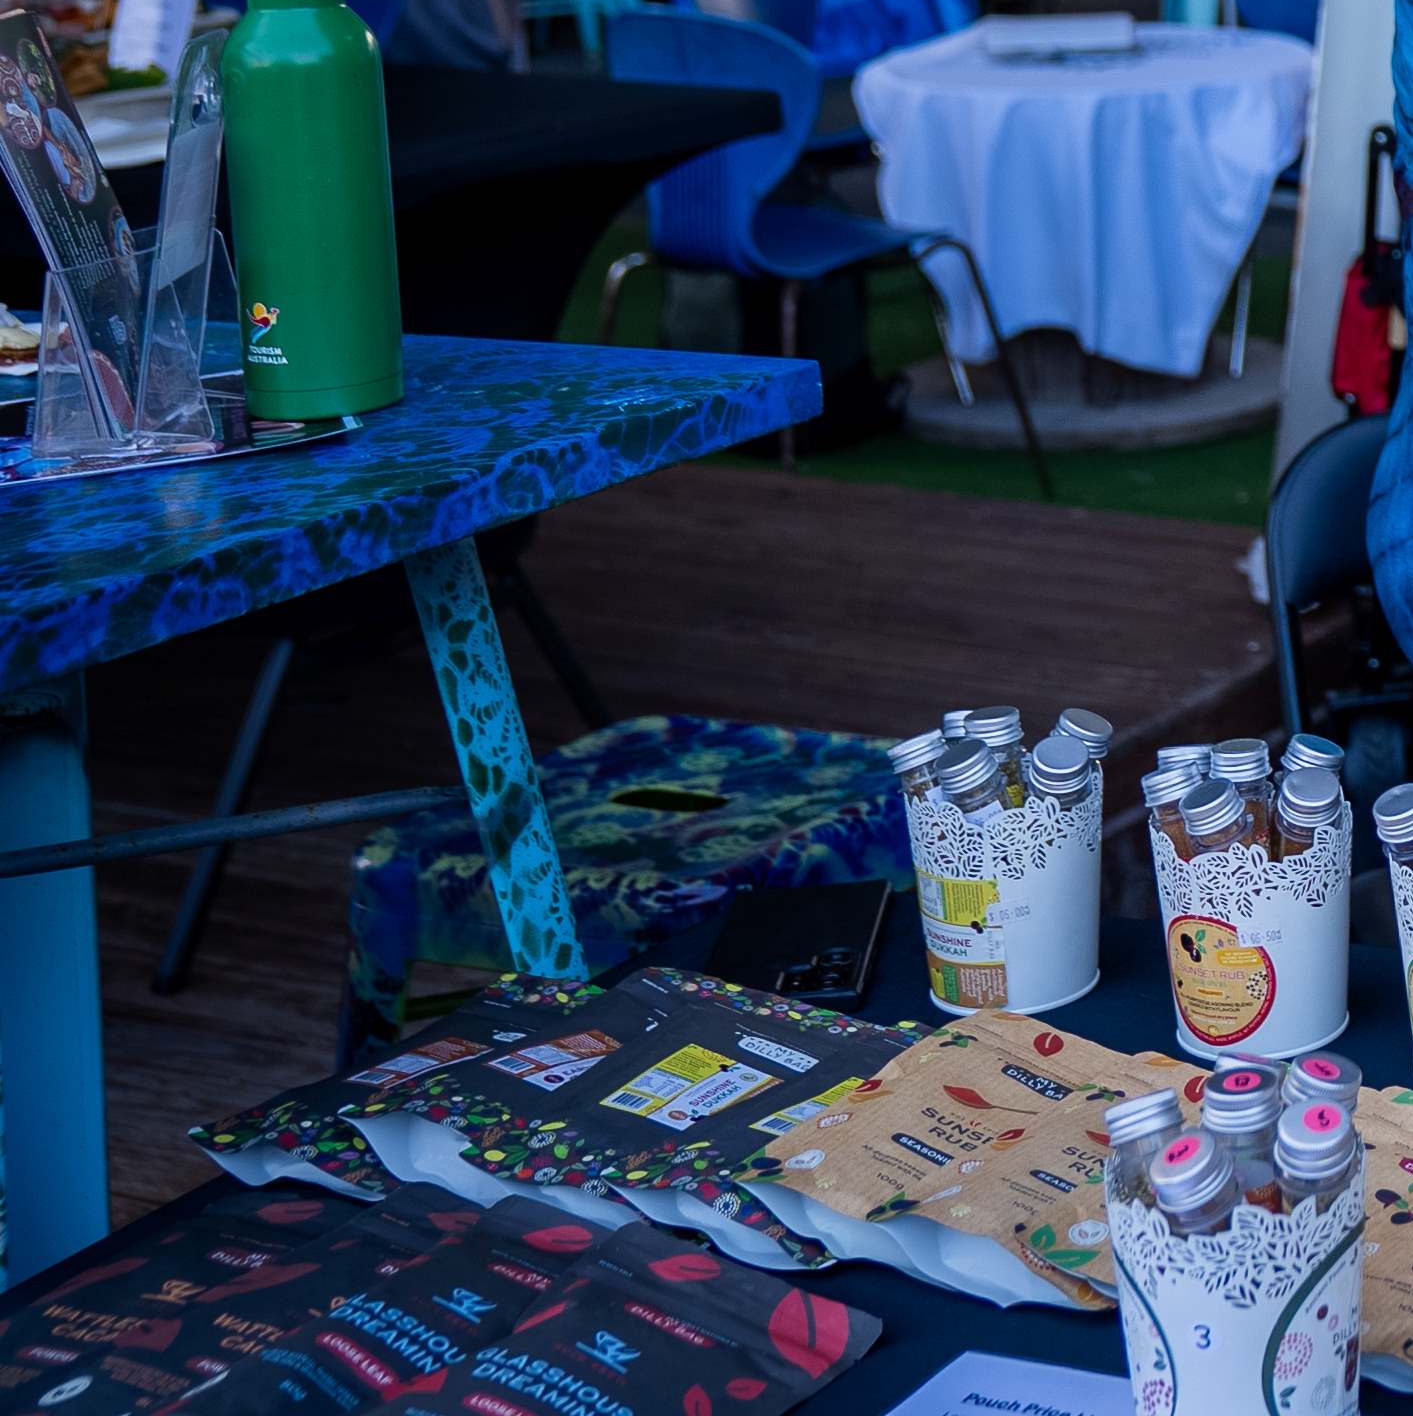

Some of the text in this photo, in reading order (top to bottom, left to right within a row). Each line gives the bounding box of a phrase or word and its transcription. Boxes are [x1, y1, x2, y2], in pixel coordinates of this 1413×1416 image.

[744, 1041, 782, 1061] DILLY
[774, 1046, 796, 1057] MY
[689, 1078, 736, 1107] SUNSHINE
[1006, 1068, 1045, 1093] DILLY
[1035, 1076, 1059, 1089] MY
[704, 1085, 742, 1109] DUKKAH
[928, 1126, 978, 1153] RUB
[328, 1306, 443, 1375] DREAMIN
[1195, 1325, 1210, 1349] 3
[472, 1365, 597, 1416] DREAMIN
[962, 1392, 1021, 1414] Pouch
